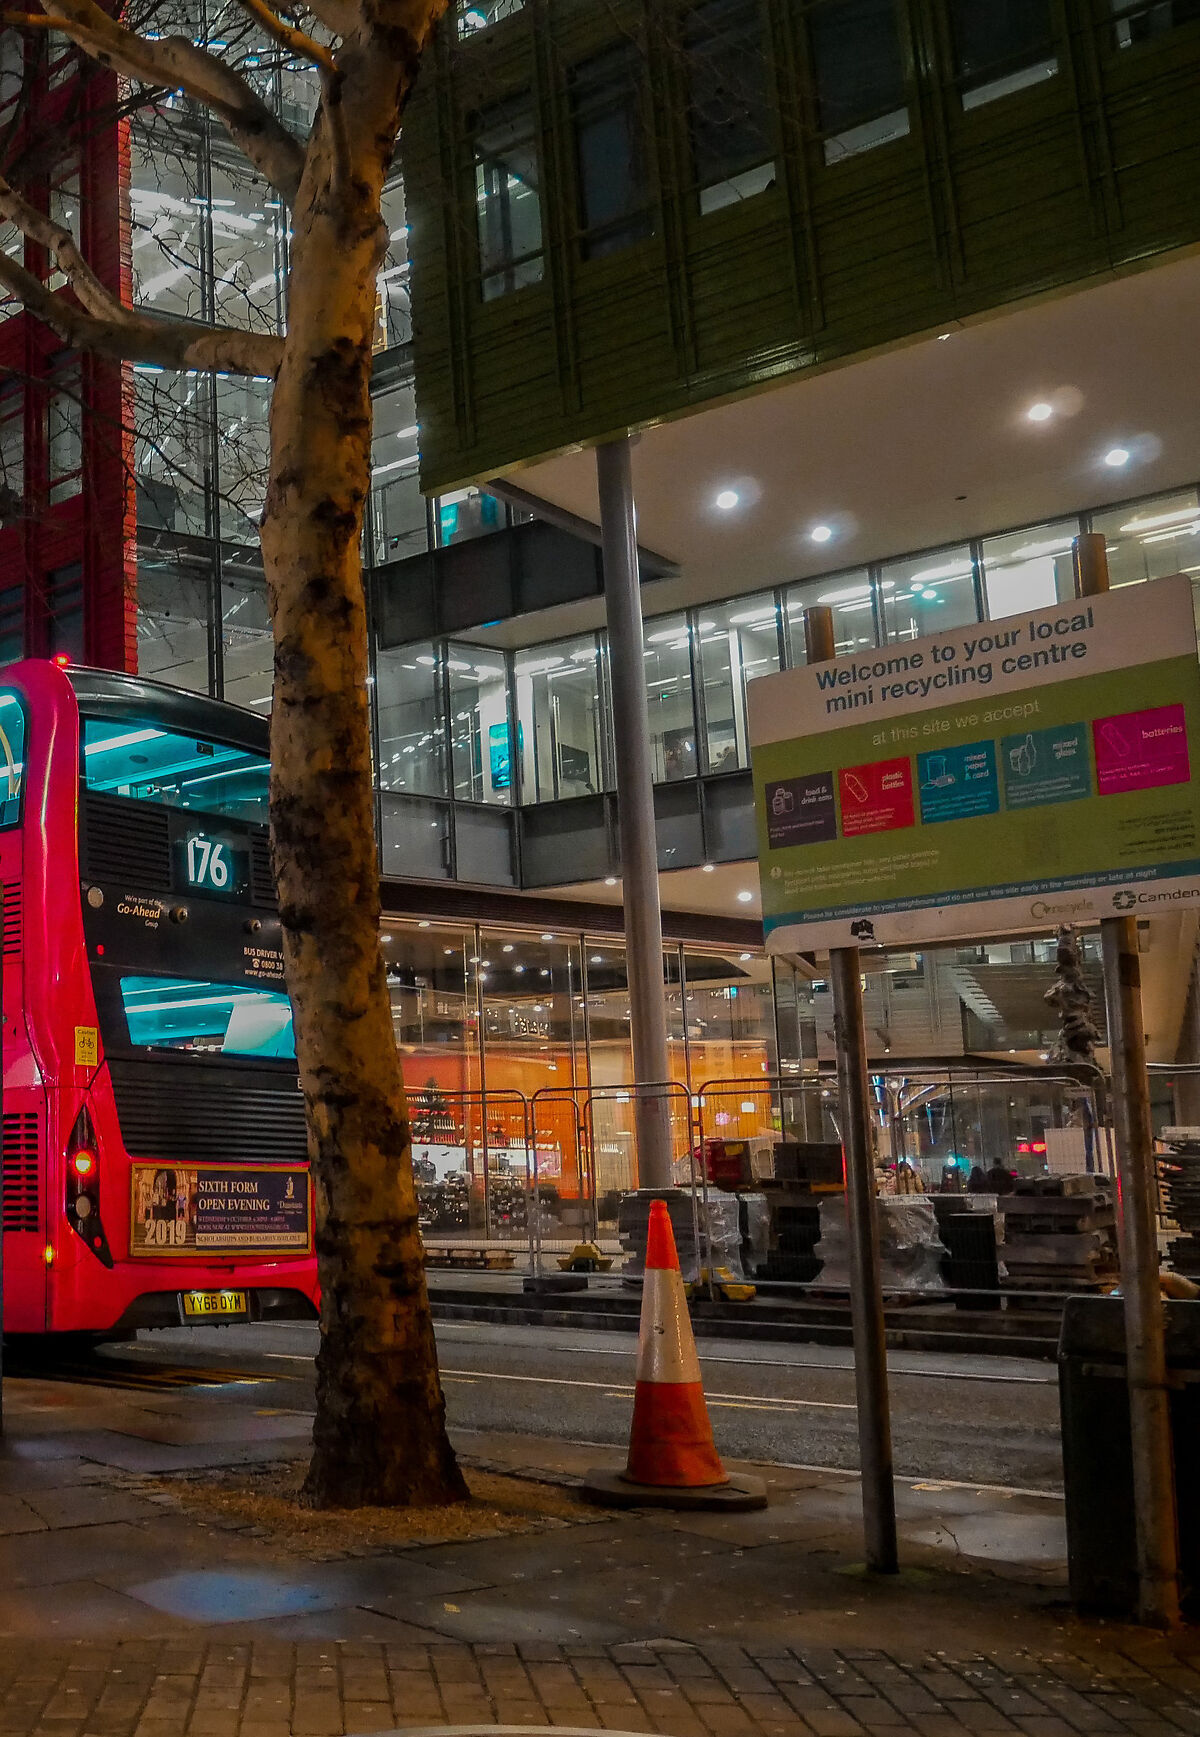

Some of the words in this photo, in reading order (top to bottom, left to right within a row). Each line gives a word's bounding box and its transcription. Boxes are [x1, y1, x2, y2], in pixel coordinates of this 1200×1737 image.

[816, 652, 924, 690] Welcome
[931, 645, 956, 664] to
[963, 628, 1021, 660] your
[1029, 607, 1094, 641] local
[826, 685, 874, 714] mini
[881, 661, 992, 701] recycling
[1001, 641, 1087, 674] centre
[872, 732, 886, 746] at
[889, 724, 918, 742] this
[922, 717, 951, 737] site
[955, 715, 978, 729] we
[983, 700, 1041, 727] accept
[1141, 725, 1183, 739] batteries
[1052, 738, 1078, 750] mixed
[964, 752, 987, 762] mixed
[964, 761, 987, 771] paper
[881, 772, 903, 783] plastic
[964, 772, 971, 780] &
[821, 786, 828, 794] &
[881, 781, 905, 791] bottles
[801, 797, 817, 805] drink
[187, 837, 228, 887] 176
[834, 905, 872, 917] considerate
[881, 902, 901, 912] your
[990, 888, 1004, 897] this
[1020, 883, 1039, 892] early
[1050, 880, 1062, 888] the
[1063, 876, 1096, 887] morning
[1108, 873, 1124, 881] late
[1136, 868, 1157, 879] night
[1137, 888, 1200, 903] Camden
[117, 903, 161, 919] Go-Ahead
[243, 947, 256, 956] BUS
[256, 949, 278, 959] DRIVER
[261, 960, 275, 970] 0800
[198, 1180, 228, 1193] SIXTH
[230, 1181, 259, 1193] FORM
[198, 1198, 226, 1211] OPEN
[228, 1199, 270, 1211] EVENING
[144, 1219, 187, 1245] 2019
[189, 1295, 218, 1311] YY66
[220, 1295, 241, 1309] OYM
